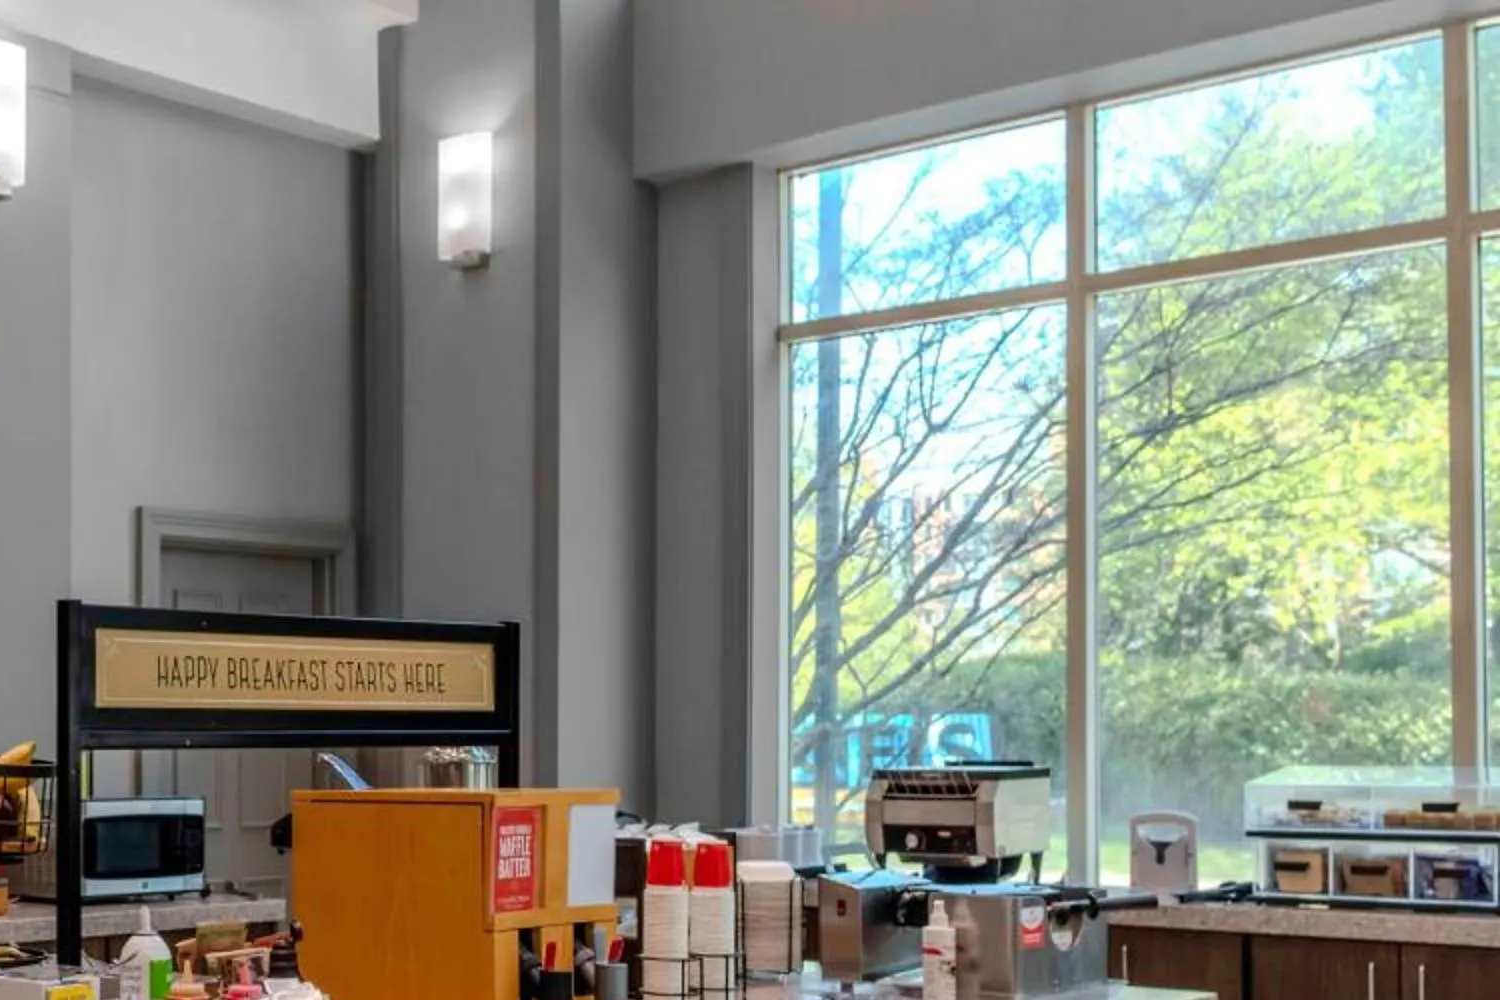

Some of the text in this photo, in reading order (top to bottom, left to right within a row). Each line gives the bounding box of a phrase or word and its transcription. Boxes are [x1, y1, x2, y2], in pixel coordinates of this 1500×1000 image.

[156, 654, 447, 695] HAPPY BREAKFAST STARTS HERE
[499, 834, 532, 857] WAFFLE
[498, 857, 531, 880] BATTER
